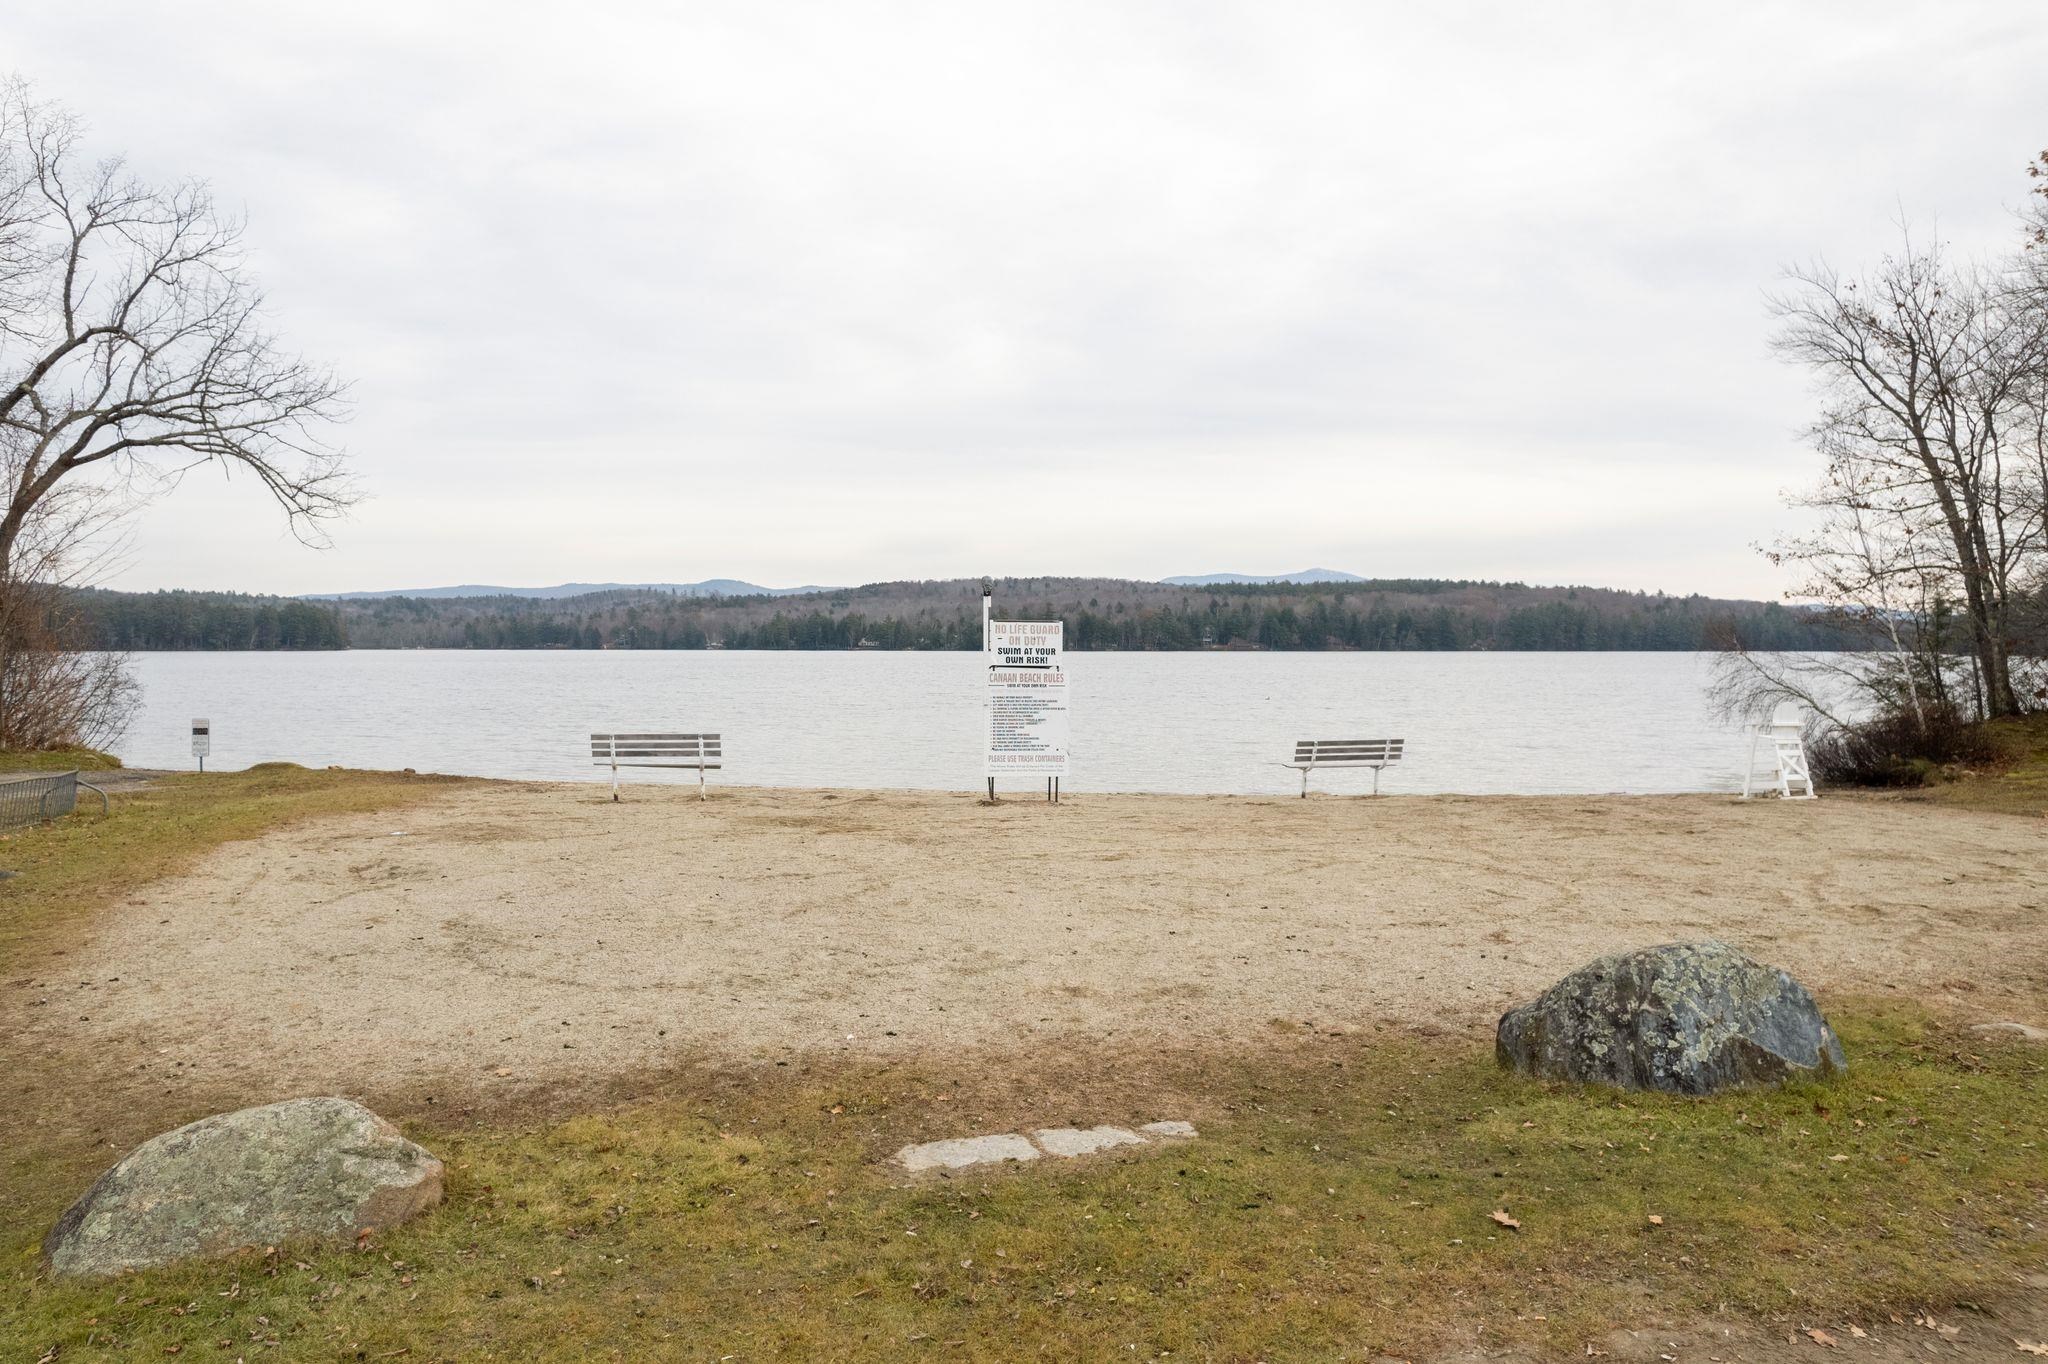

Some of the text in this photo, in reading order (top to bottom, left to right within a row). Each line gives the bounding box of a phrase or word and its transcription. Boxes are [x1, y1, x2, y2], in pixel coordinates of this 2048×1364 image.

[995, 624, 1060, 634] NO LIFE GUARD
[1009, 636, 1046, 646] ON DUTY
[990, 673, 1064, 683] CANAAN BEACH RULES
